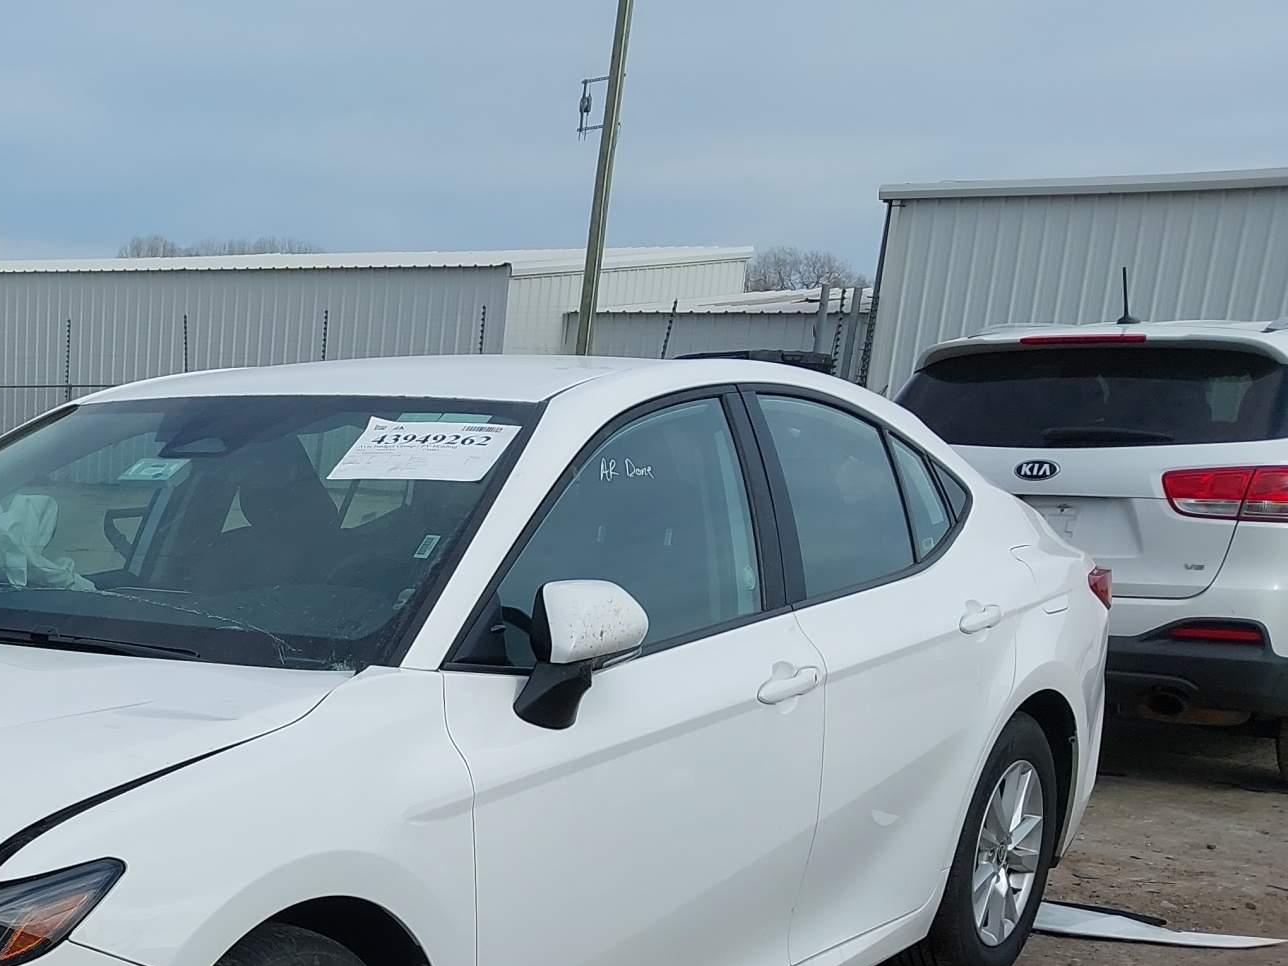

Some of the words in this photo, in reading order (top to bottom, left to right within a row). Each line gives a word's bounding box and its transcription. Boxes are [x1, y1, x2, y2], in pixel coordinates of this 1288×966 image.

[371, 433, 492, 446] 43949262
[625, 457, 655, 479] Done
[1020, 463, 1050, 476] KIA
